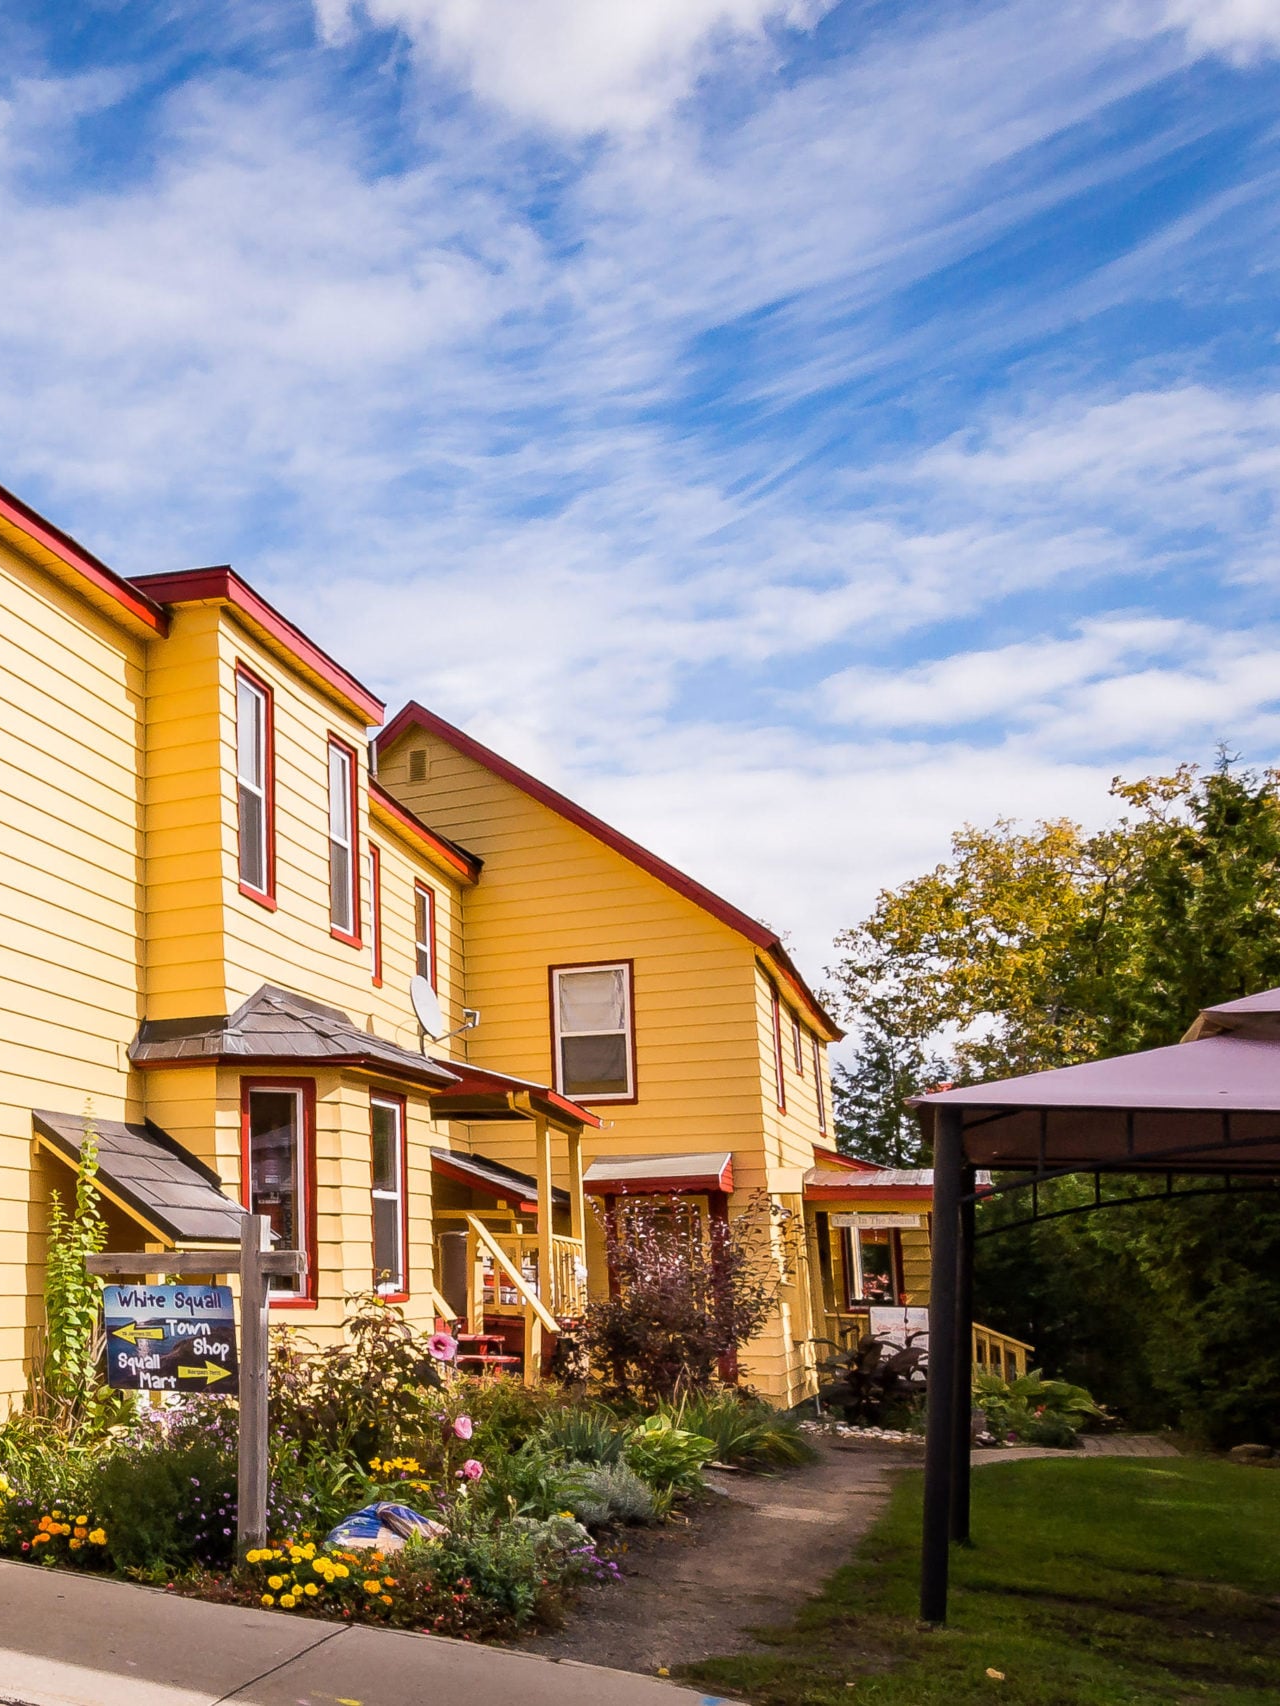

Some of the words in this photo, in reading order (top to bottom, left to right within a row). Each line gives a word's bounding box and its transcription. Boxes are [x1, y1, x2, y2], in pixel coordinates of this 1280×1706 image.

[870, 1215, 886, 1224] The
[888, 1215, 916, 1224] Sound
[117, 1290, 166, 1309] White
[174, 1291, 222, 1316] Squall
[165, 1319, 211, 1337] Town
[193, 1337, 230, 1361] Shop
[118, 1352, 161, 1376] Squall
[139, 1372, 177, 1389] Mart
